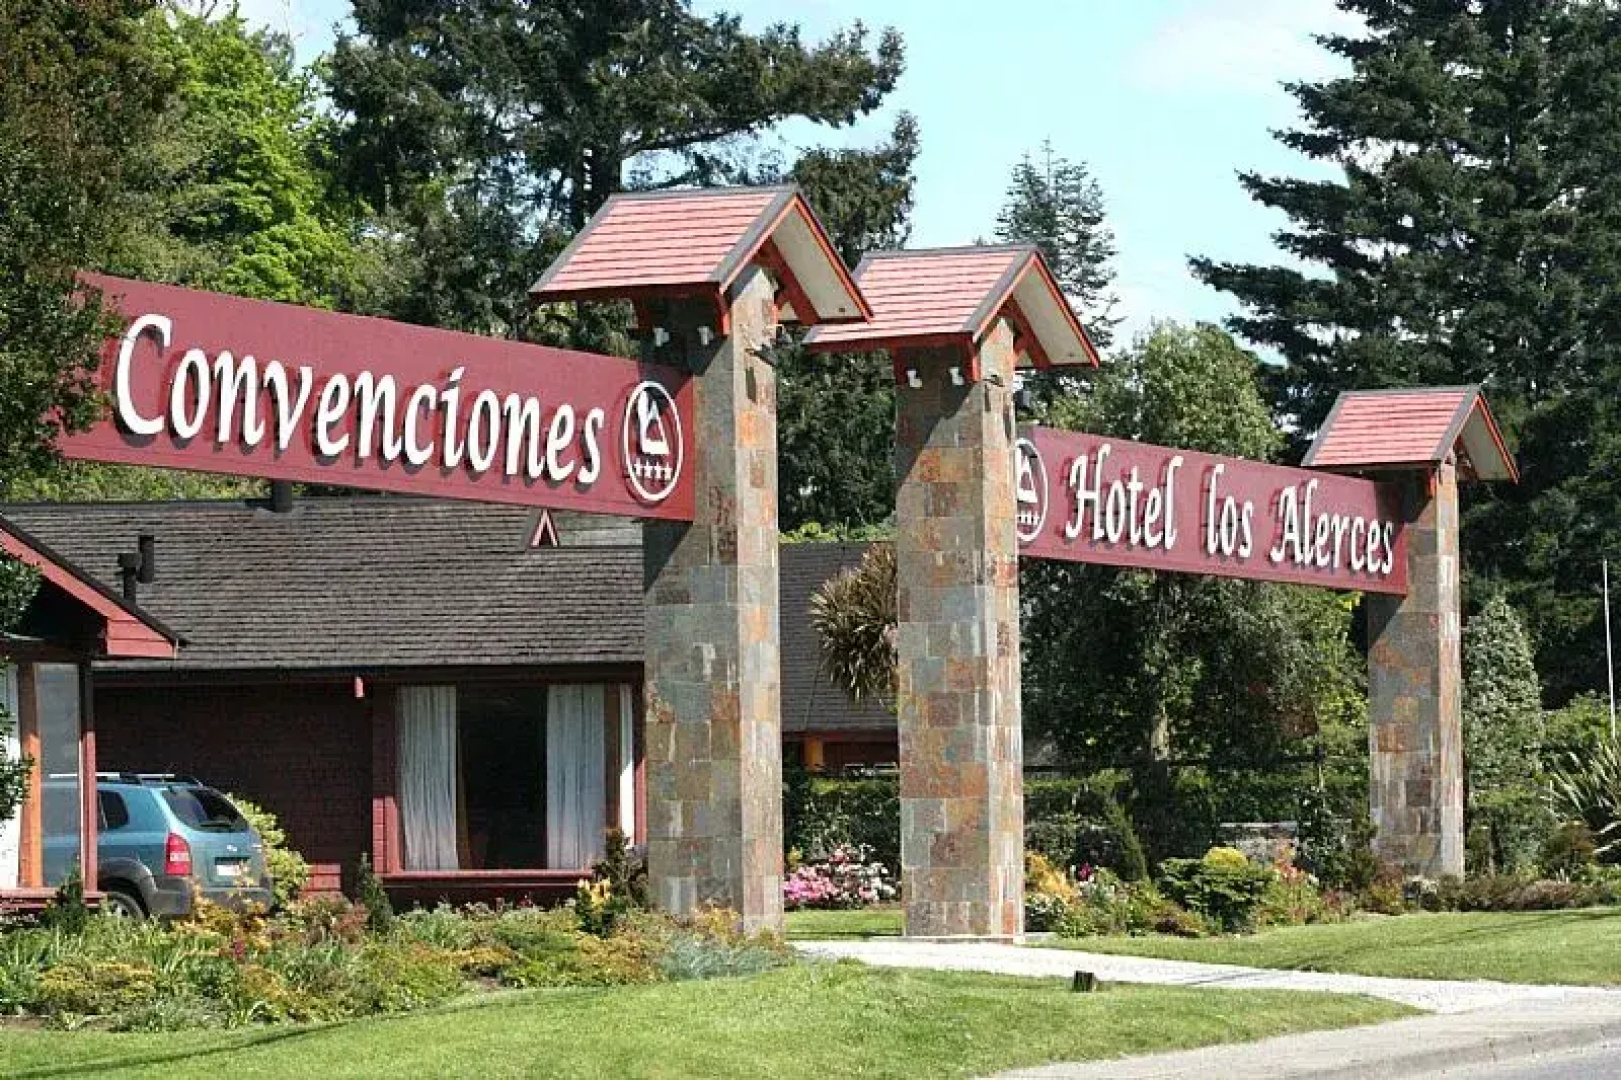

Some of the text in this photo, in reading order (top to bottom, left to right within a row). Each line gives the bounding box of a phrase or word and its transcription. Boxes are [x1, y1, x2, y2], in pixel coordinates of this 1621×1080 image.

[114, 313, 605, 484] Convenciones
[1065, 443, 1184, 550] Hotel
[1269, 478, 1394, 574] Alerces
